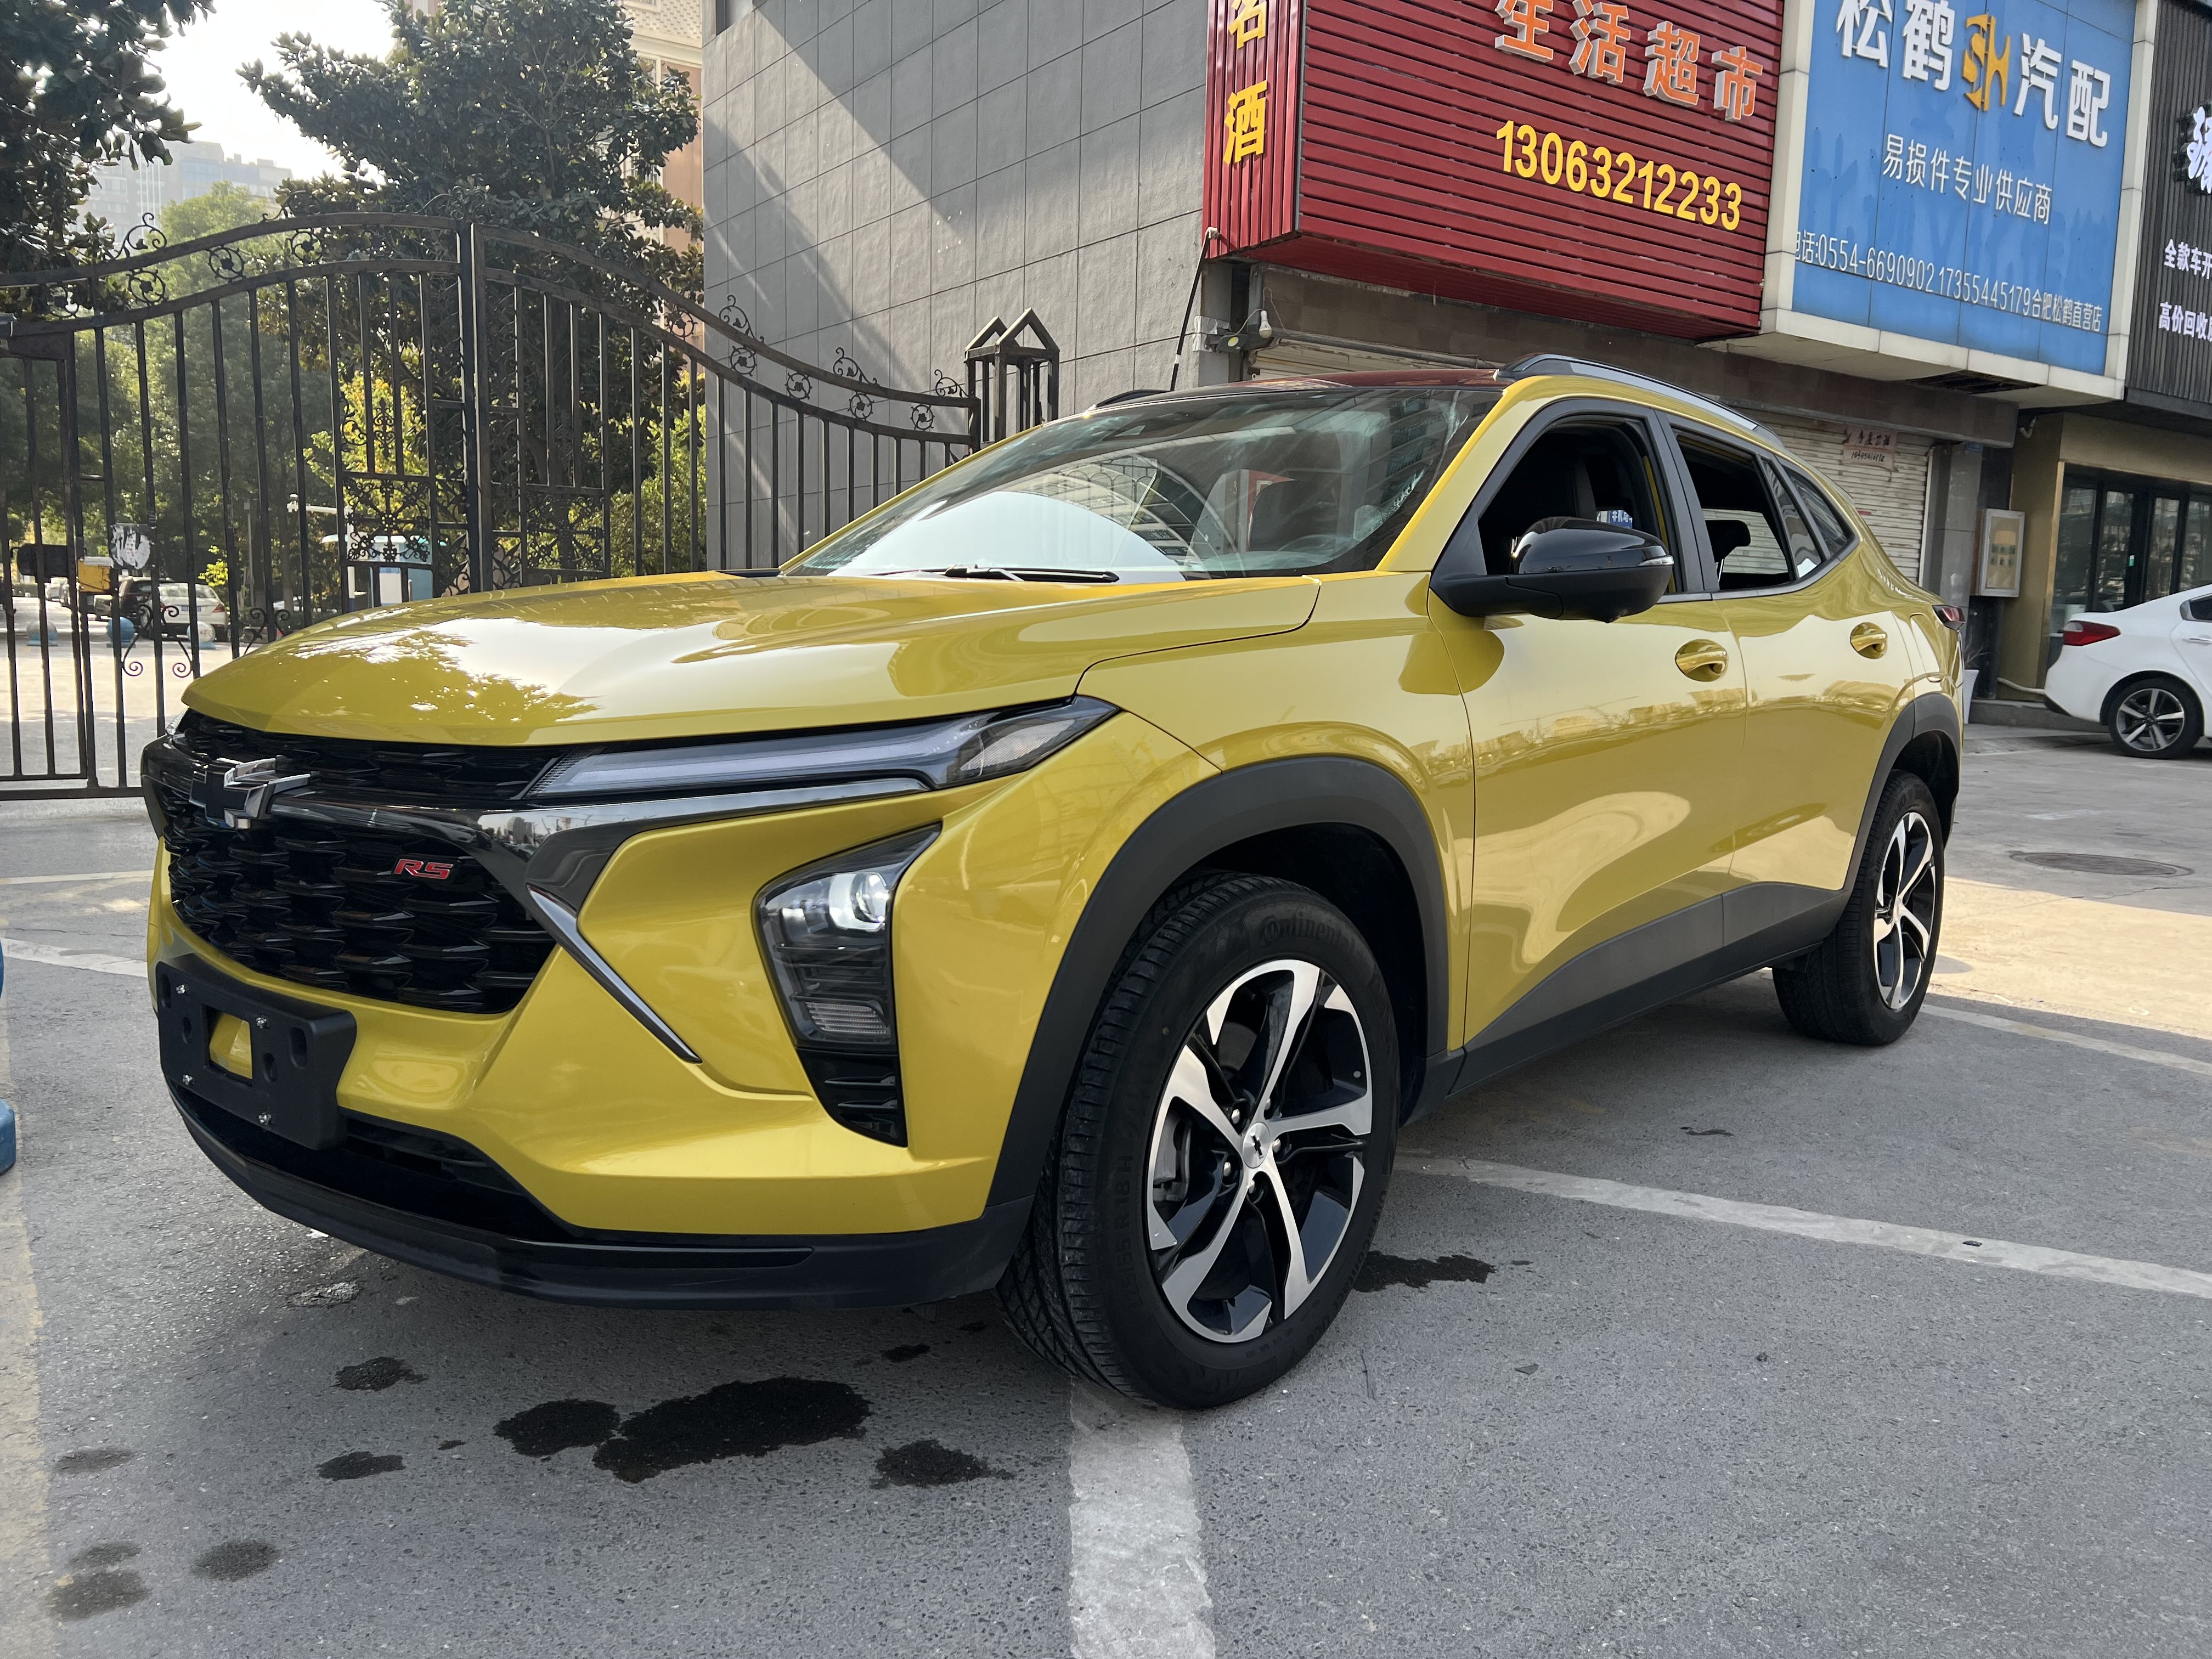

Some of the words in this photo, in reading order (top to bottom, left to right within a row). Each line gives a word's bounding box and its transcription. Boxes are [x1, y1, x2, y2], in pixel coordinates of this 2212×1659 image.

[1223, 0, 1267, 165] 名酒
[1494, 0, 1763, 121] 生活超市
[1496, 120, 1742, 230] 13063212233
[1882, 133, 2052, 224] 易损件专业供应商
[394, 859, 454, 879] RS
